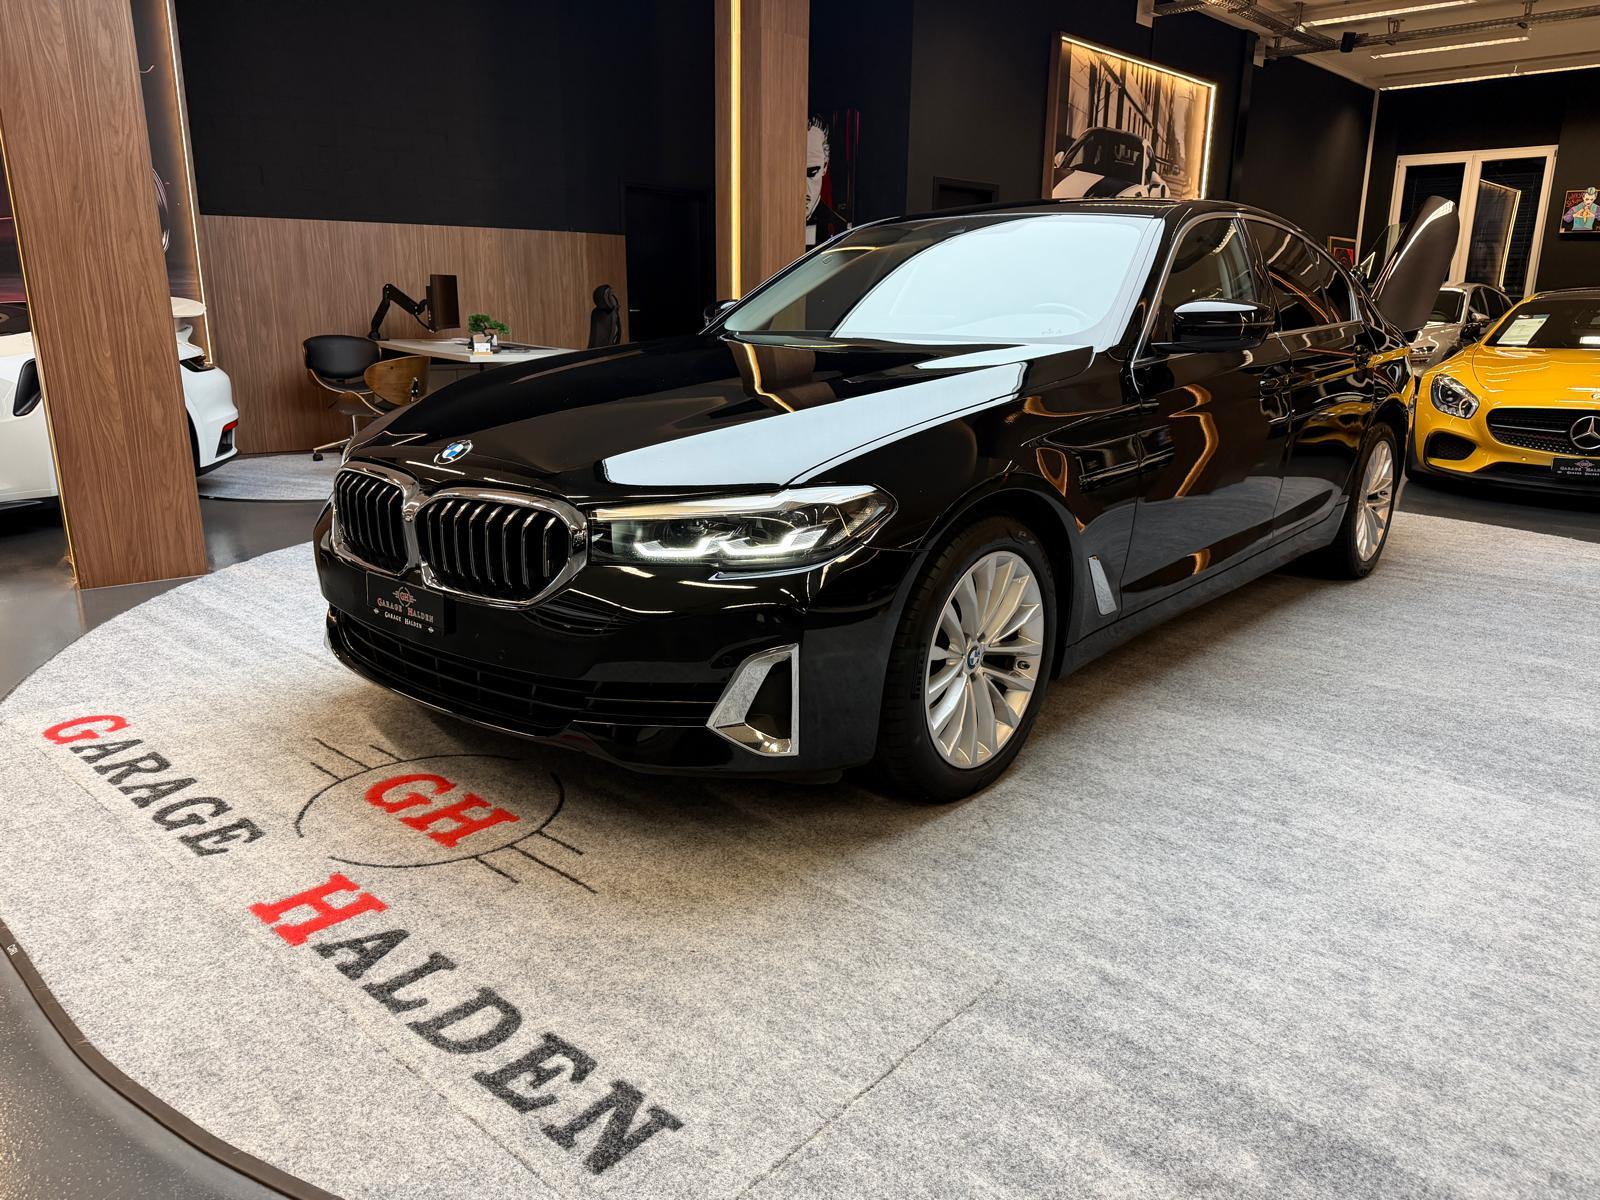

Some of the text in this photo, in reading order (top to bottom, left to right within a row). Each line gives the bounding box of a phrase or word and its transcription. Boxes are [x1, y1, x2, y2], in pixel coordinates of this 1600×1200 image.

[377, 597, 433, 622] GARAGE HALDEN
[364, 772, 519, 848] GH
[43, 714, 684, 1175] GARAGE HALDEN
